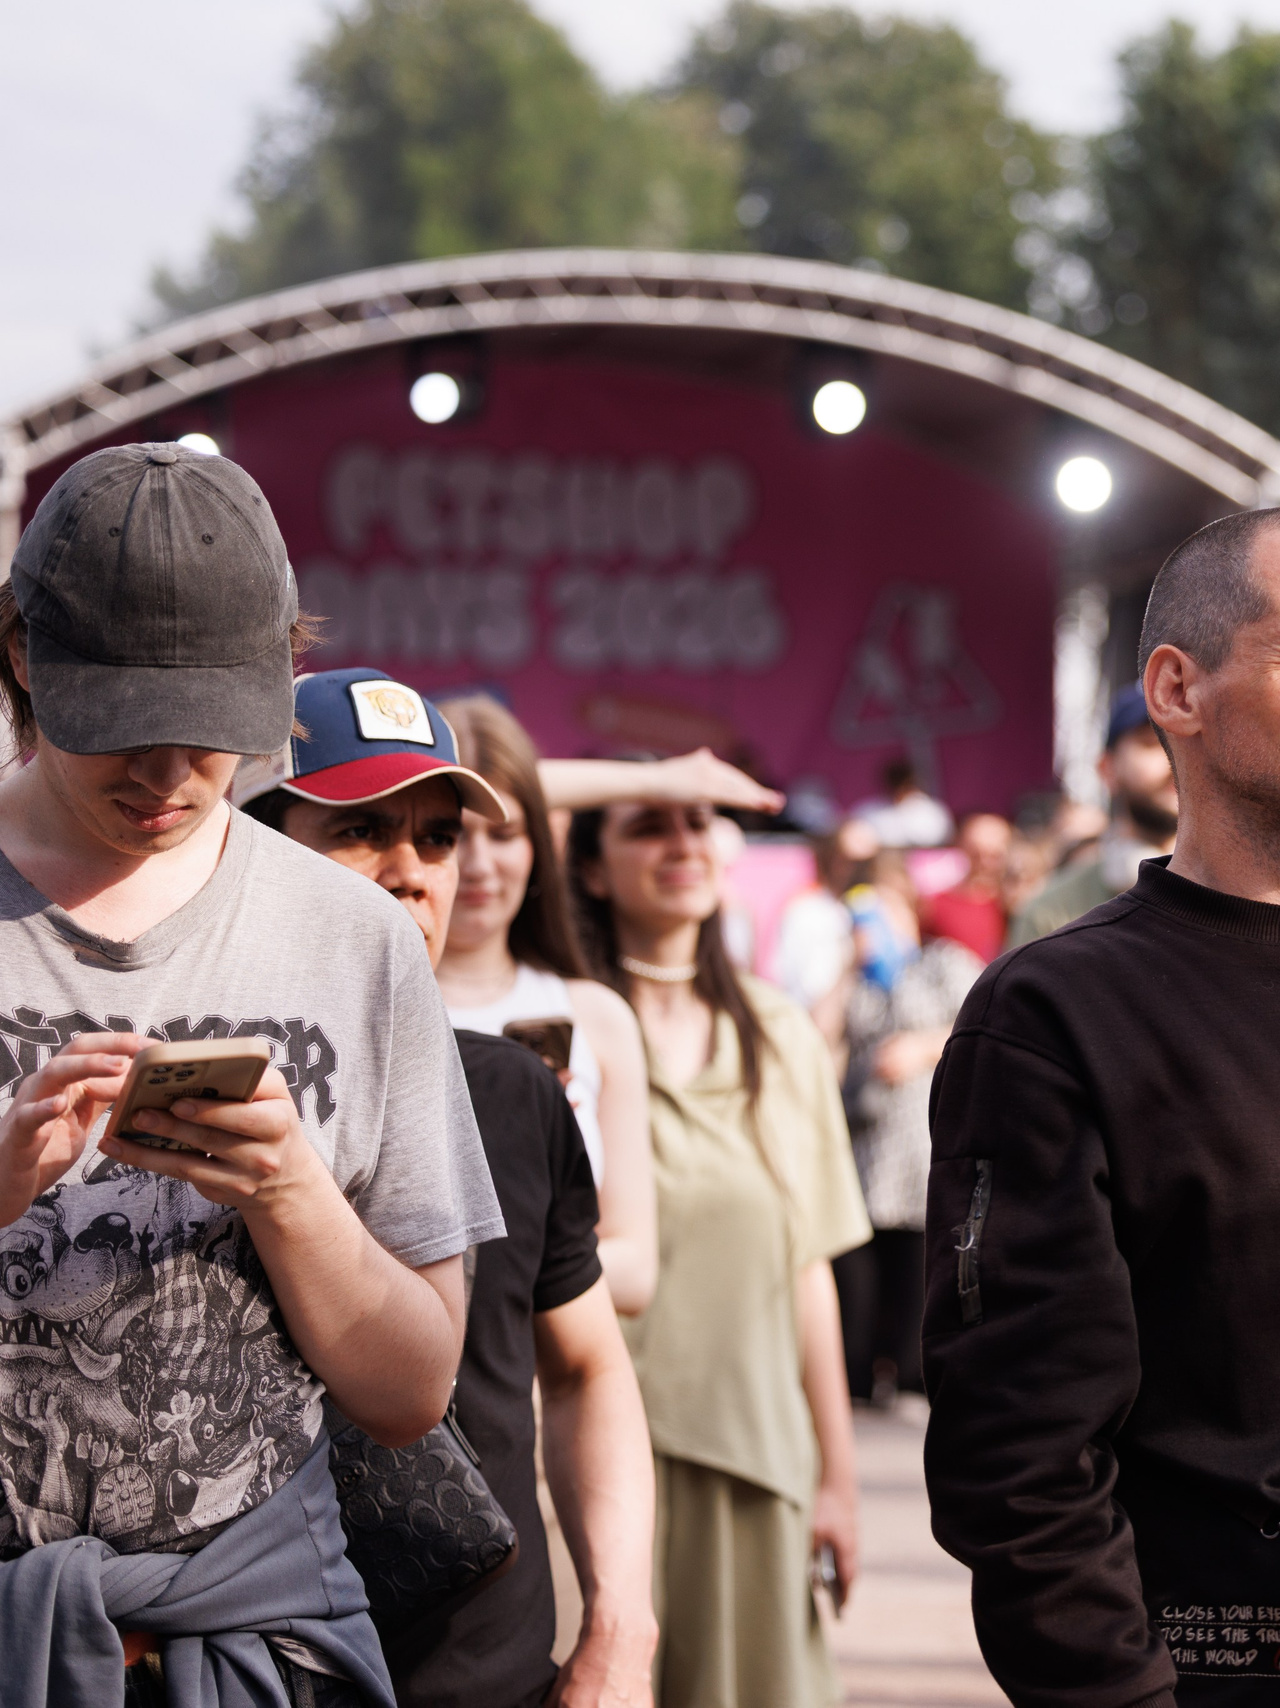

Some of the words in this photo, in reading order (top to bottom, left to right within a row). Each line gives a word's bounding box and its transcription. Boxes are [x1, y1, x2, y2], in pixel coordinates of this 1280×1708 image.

[325, 444, 758, 562] PETSHOP
[547, 562, 788, 674] 2026
[1161, 1605, 1215, 1620] CLOSE
[1219, 1605, 1253, 1620] YOUR
[1161, 1626, 1182, 1642] TO
[1186, 1627, 1216, 1642] SEE
[1221, 1627, 1250, 1644] THE
[1171, 1648, 1200, 1664] THE
[1205, 1648, 1259, 1666] WORLD
